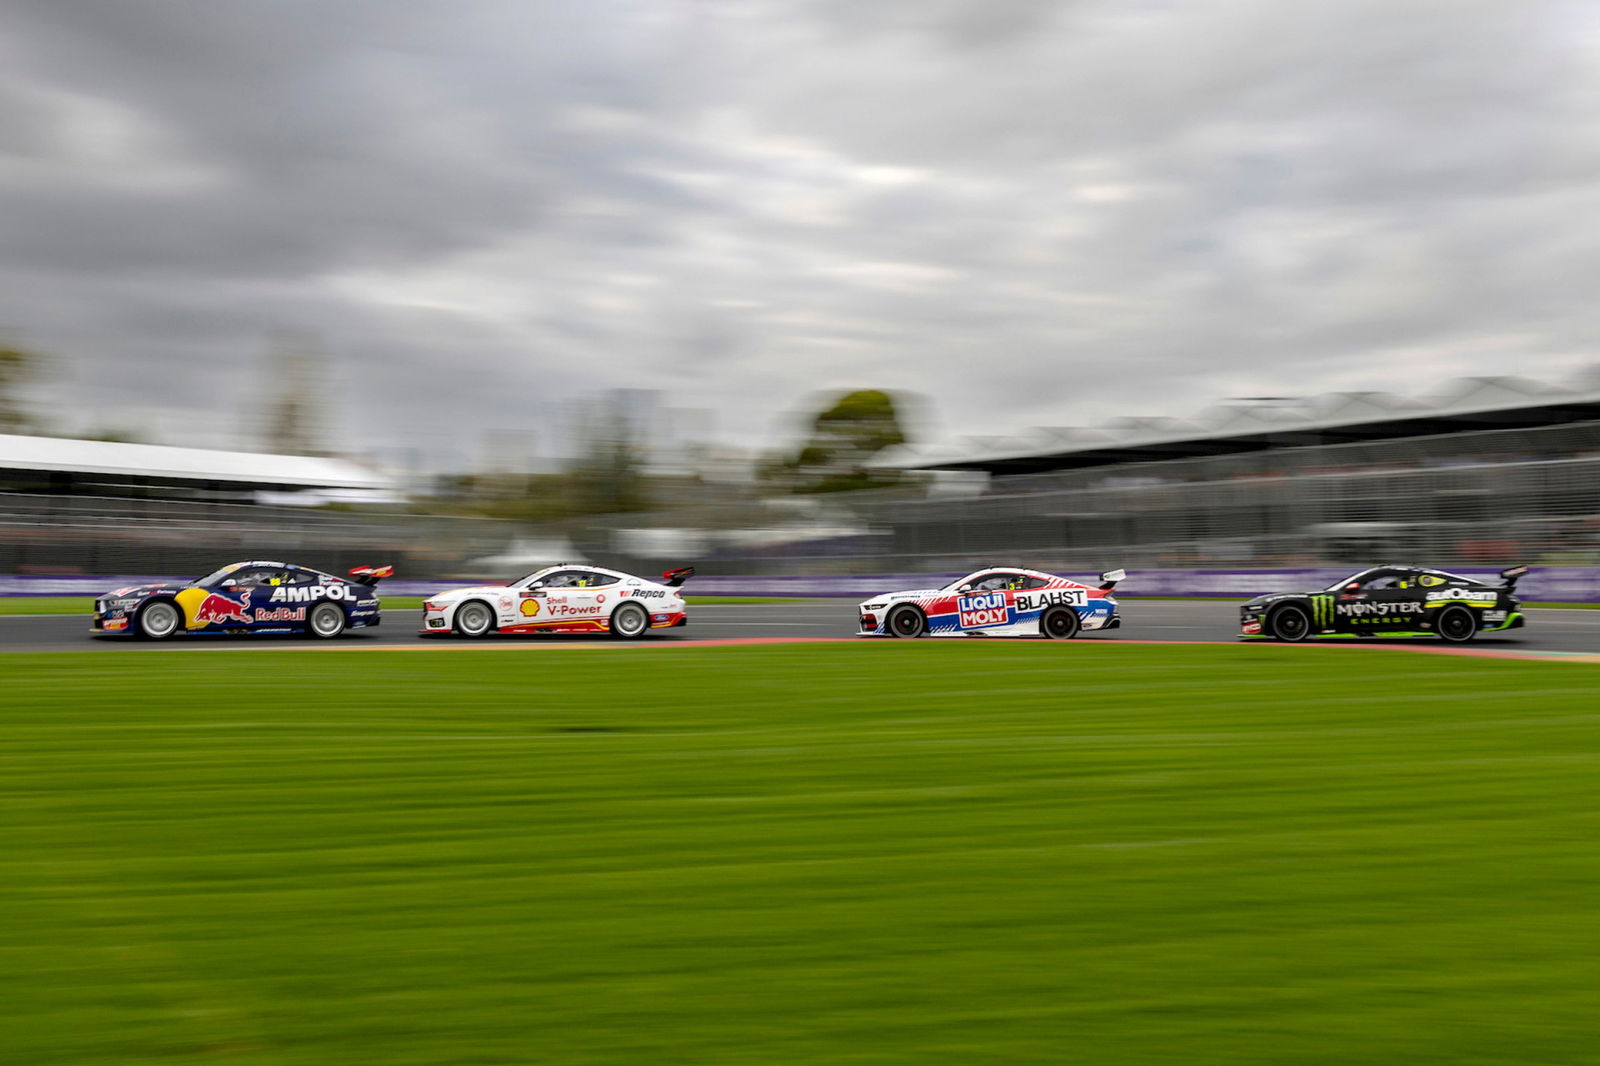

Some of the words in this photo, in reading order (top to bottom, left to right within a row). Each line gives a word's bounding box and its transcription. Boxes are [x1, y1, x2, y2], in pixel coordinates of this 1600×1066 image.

[269, 585, 357, 602] AMPOL
[546, 596, 568, 604] Shell
[631, 589, 666, 599] Repco
[1016, 590, 1084, 612] BLAHST
[547, 605, 602, 616] V-Power
[961, 595, 1003, 612] LIQUI
[1336, 601, 1424, 617] MONSTER
[255, 607, 280, 621] Red
[281, 606, 306, 621] Bull
[963, 609, 1005, 626] MOLY
